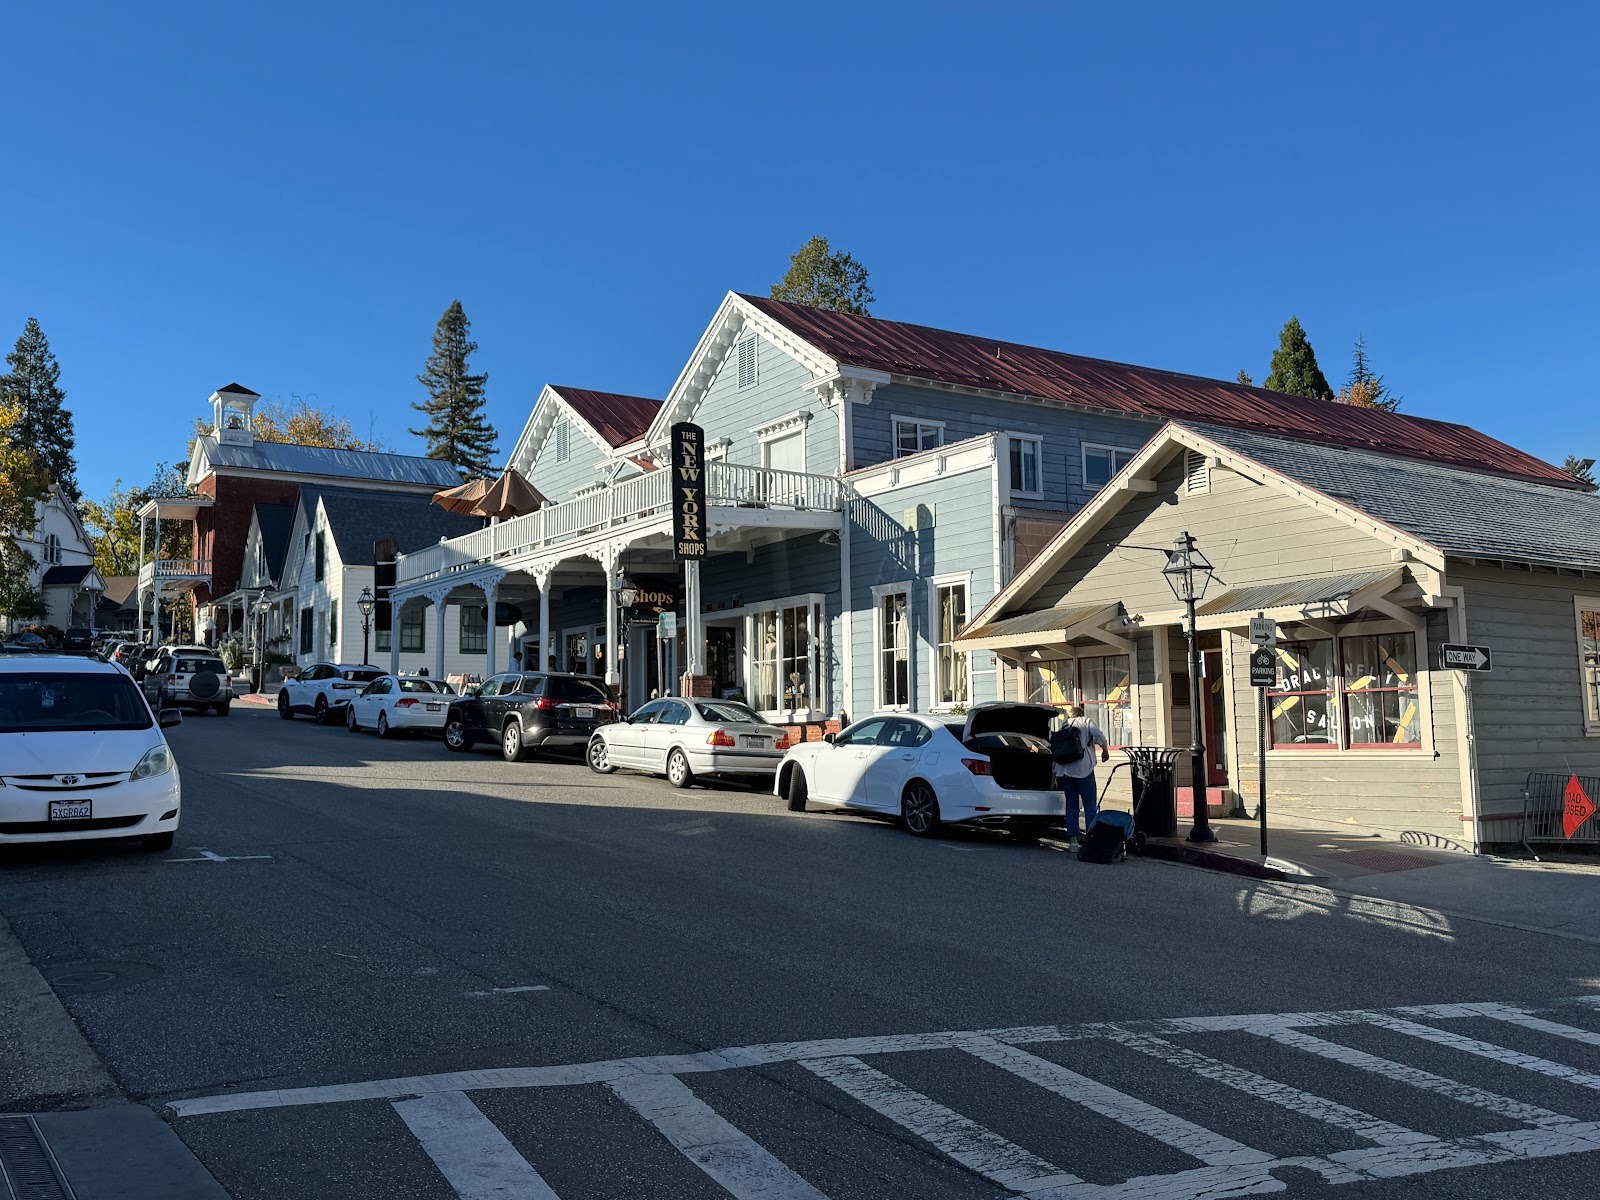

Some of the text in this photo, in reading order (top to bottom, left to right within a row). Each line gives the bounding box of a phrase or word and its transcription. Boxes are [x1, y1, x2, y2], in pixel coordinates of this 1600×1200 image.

[681, 431, 697, 440] THE
[679, 441, 700, 541] NEW YORK
[678, 542, 705, 555] SHOPS
[1253, 622, 1273, 632] PARKING
[1448, 651, 1476, 663] ONE WAY
[1251, 667, 1275, 675] PARKING
[1565, 792, 1582, 804] OAD
